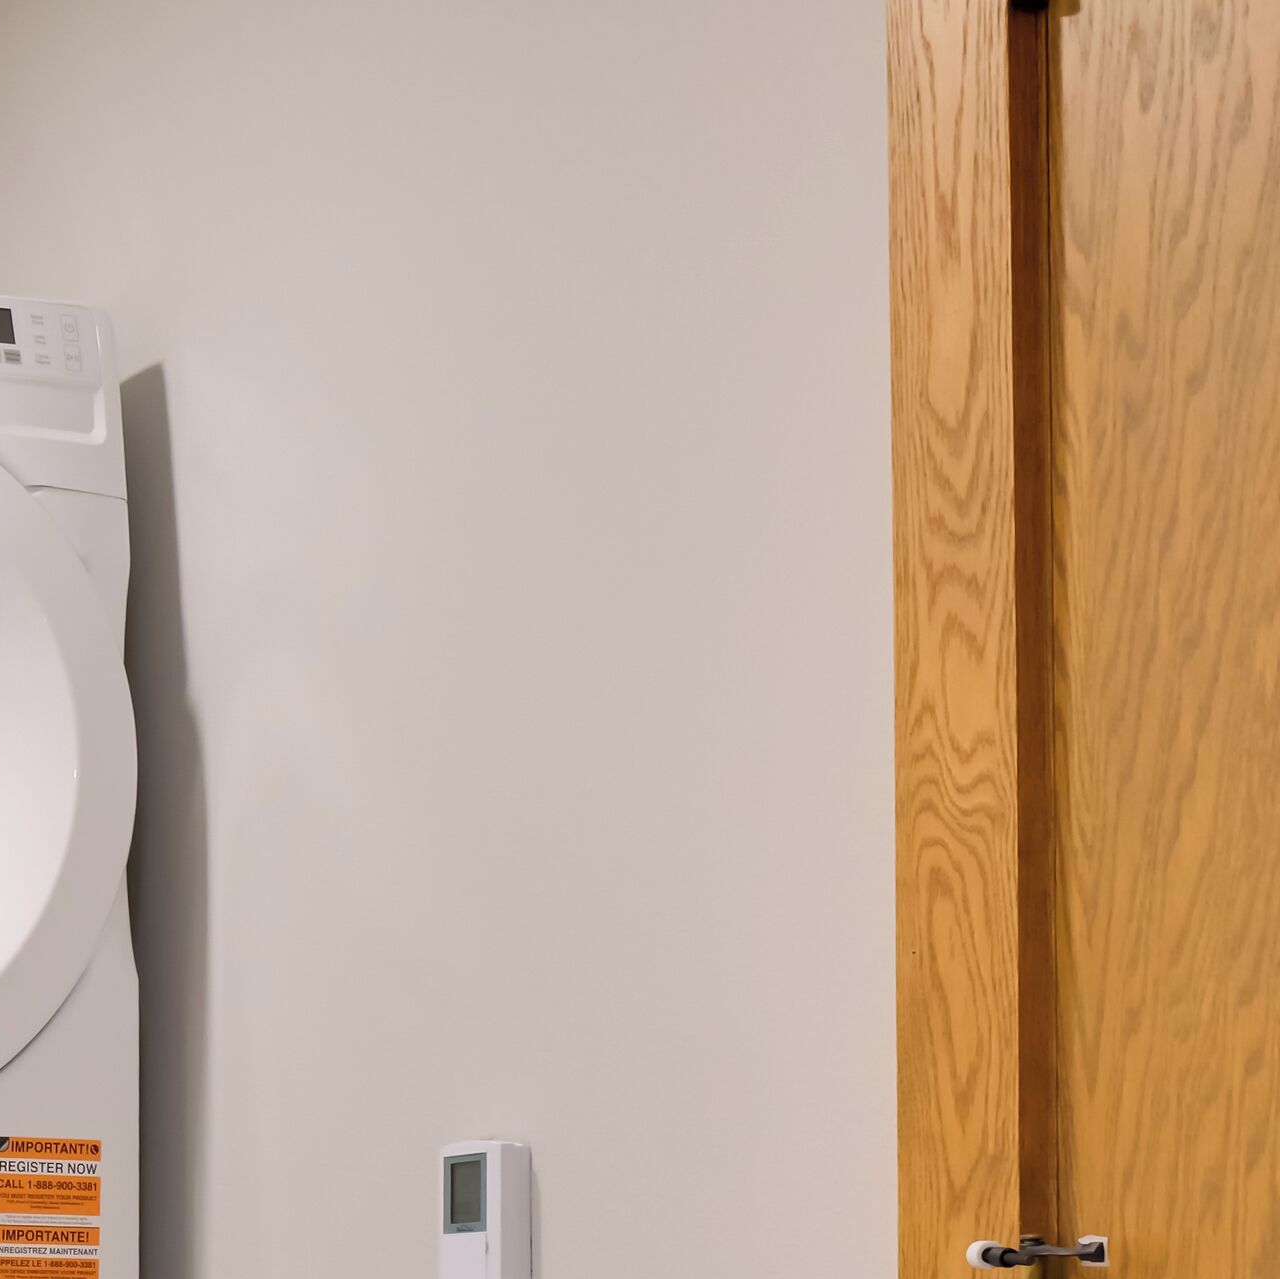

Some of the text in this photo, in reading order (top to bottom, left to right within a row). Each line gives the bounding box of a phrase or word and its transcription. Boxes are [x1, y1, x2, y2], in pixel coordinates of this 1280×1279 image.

[11, 1140, 90, 1155] IMPORTANT!
[67, 1163, 98, 1175] NOW
[27, 1180, 98, 1192] 1-888-900-3381
[1, 1229, 90, 1243] IMPORTANTE!
[49, 1247, 99, 1256] MAINTENANT
[31, 1260, 42, 1268] LE
